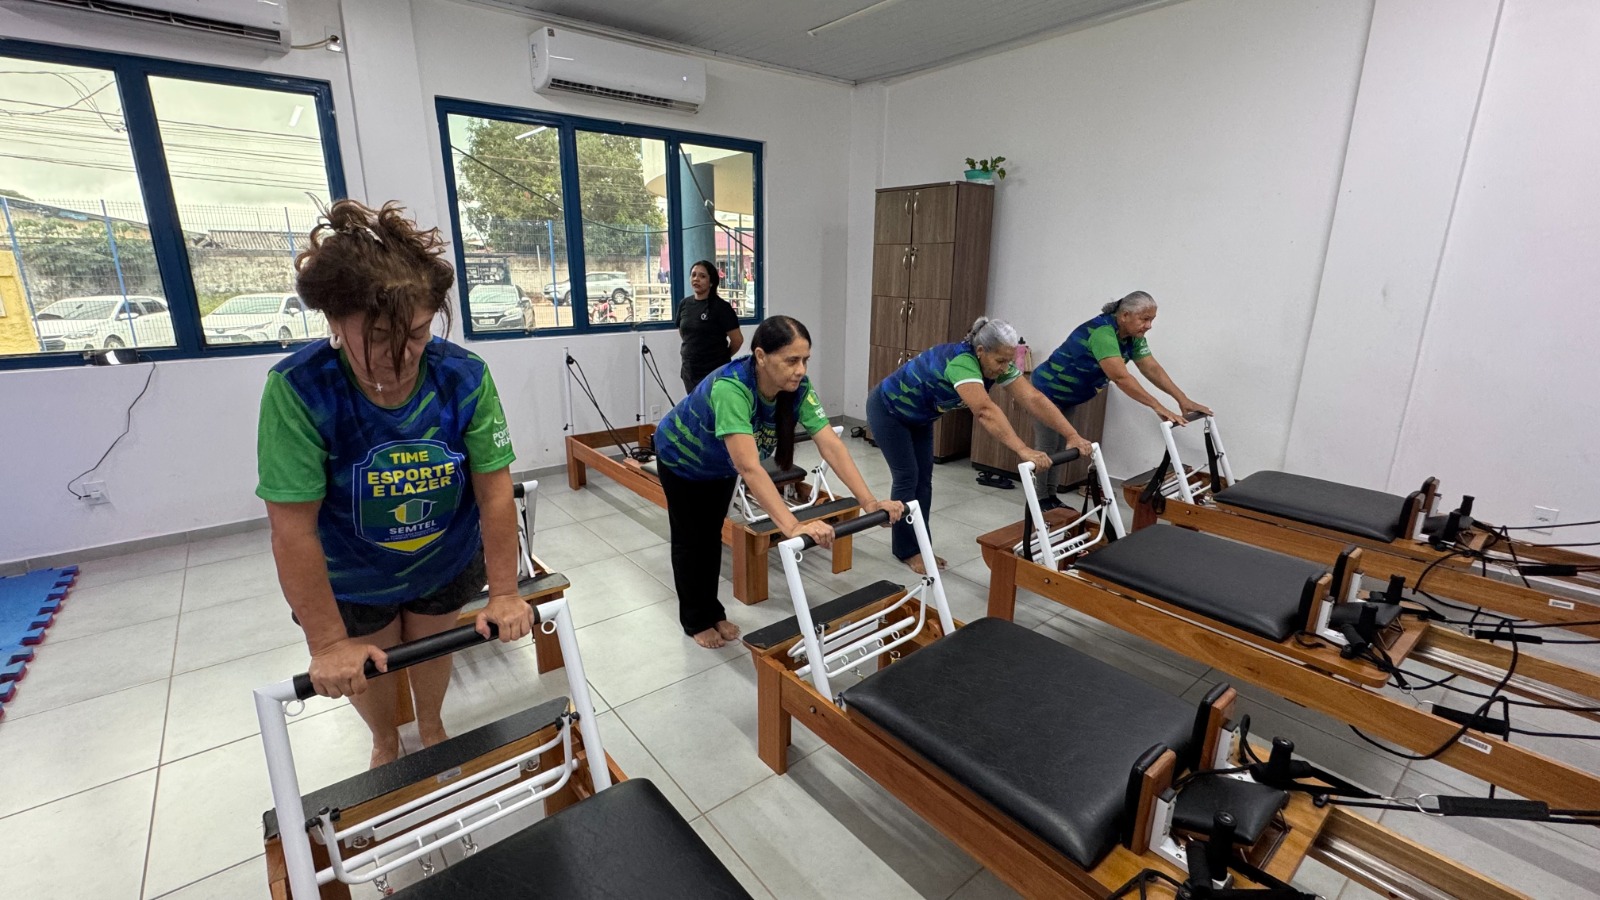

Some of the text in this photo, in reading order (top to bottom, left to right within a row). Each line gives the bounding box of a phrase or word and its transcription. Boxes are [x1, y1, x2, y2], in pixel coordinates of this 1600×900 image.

[389, 450, 430, 464] TIME
[367, 461, 455, 485] ESPORTE
[373, 475, 452, 497] E LAZER
[389, 519, 437, 535] SEMTEL
